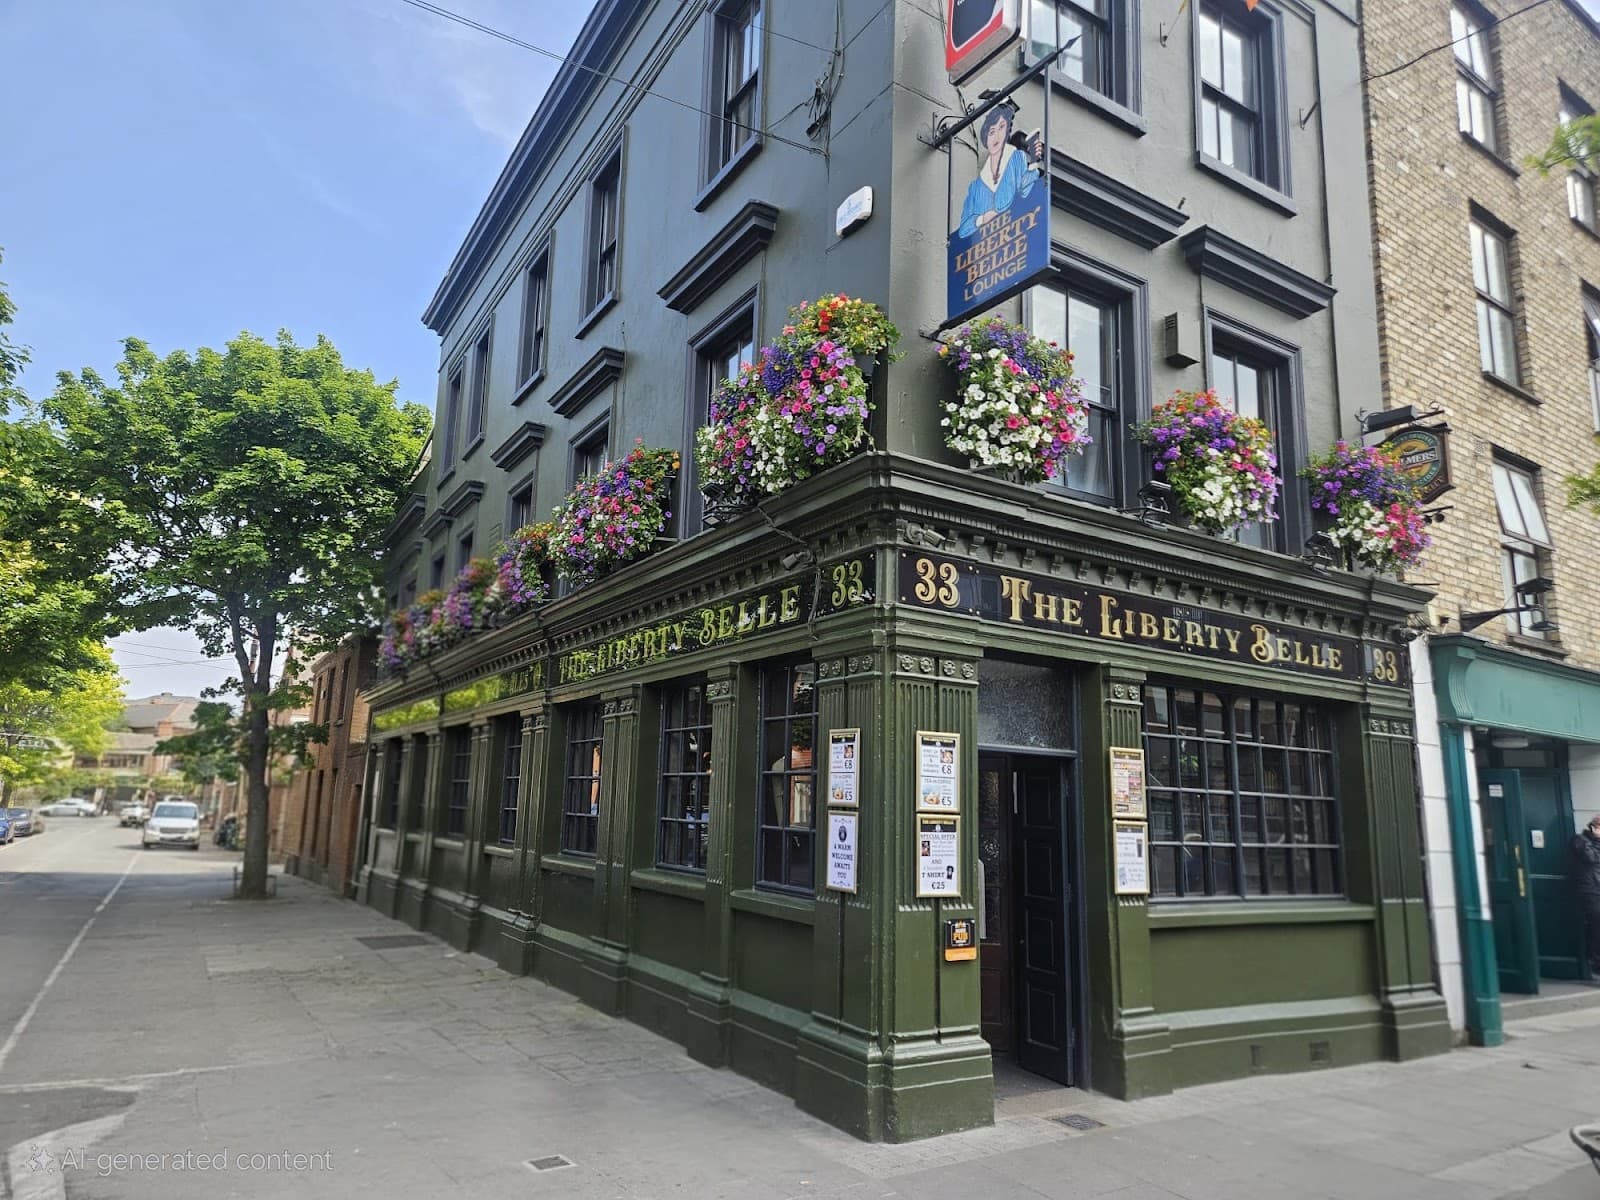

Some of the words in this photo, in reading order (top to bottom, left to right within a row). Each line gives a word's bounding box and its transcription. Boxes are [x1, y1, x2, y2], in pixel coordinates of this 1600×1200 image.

[955, 206, 1040, 272] LIBERTY
[980, 210, 1012, 237] THE
[964, 254, 1027, 301] LOUNGE
[966, 234, 1027, 284] BELLE
[831, 559, 863, 608] 33
[915, 558, 960, 608] 33
[700, 585, 801, 645] BELLE
[1001, 574, 1083, 627] THE
[1099, 594, 1242, 653] LIBERTY
[1251, 624, 1344, 671] BELLE
[1374, 648, 1398, 682] 33
[941, 764, 952, 775] €8
[941, 796, 952, 806] €5
[832, 852, 853, 861] WELCOME
[833, 862, 851, 870] AWAITS
[931, 881, 945, 890] €25
